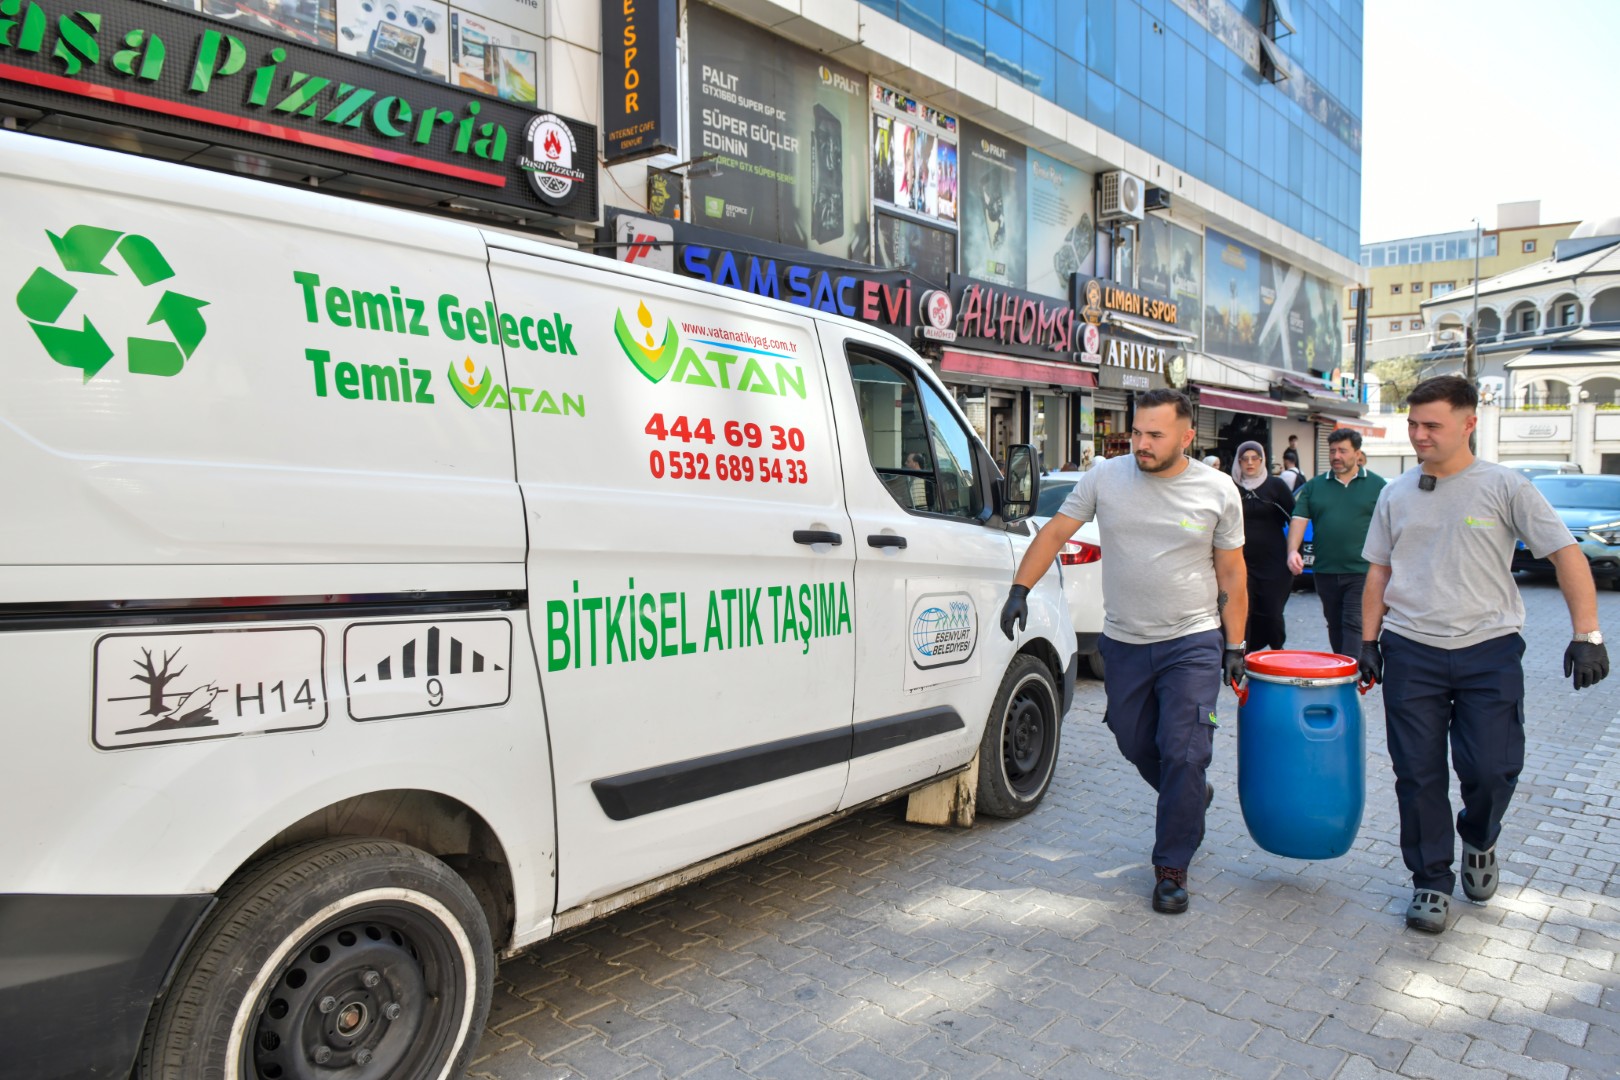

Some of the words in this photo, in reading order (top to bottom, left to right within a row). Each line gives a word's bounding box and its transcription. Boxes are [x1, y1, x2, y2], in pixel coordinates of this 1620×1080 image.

[190, 28, 508, 162] Pizzeria
[702, 83, 737, 105] GTX1660
[738, 96, 764, 114] SUPER
[609, 125, 638, 141] INTERNET
[639, 121, 655, 133] CAFE
[702, 108, 748, 138] SÜPER
[750, 124, 800, 154] GÜÇLER
[545, 161, 585, 180] Pizzeria
[739, 162, 753, 173] GTX
[293, 270, 429, 336] Temiz
[438, 294, 578, 355] Gelecek
[1142, 296, 1177, 324] E-SPOR
[681, 322, 797, 353] www.vatanatikyag.com.tr
[305, 348, 435, 404] Temiz
[644, 412, 716, 445] 444
[724, 420, 762, 448] 69
[770, 425, 805, 452] 30
[650, 449, 665, 479] 0
[669, 451, 710, 480] 532
[715, 453, 754, 482] 689
[759, 456, 783, 483] 54
[786, 459, 808, 484] 33
[547, 577, 697, 673] BİTKİSEL
[703, 587, 763, 653] ATIK
[768, 581, 852, 655] TAŞIMA
[935, 629, 971, 643] ESENYURT
[235, 678, 317, 718] H14
[426, 678, 444, 707] 9
